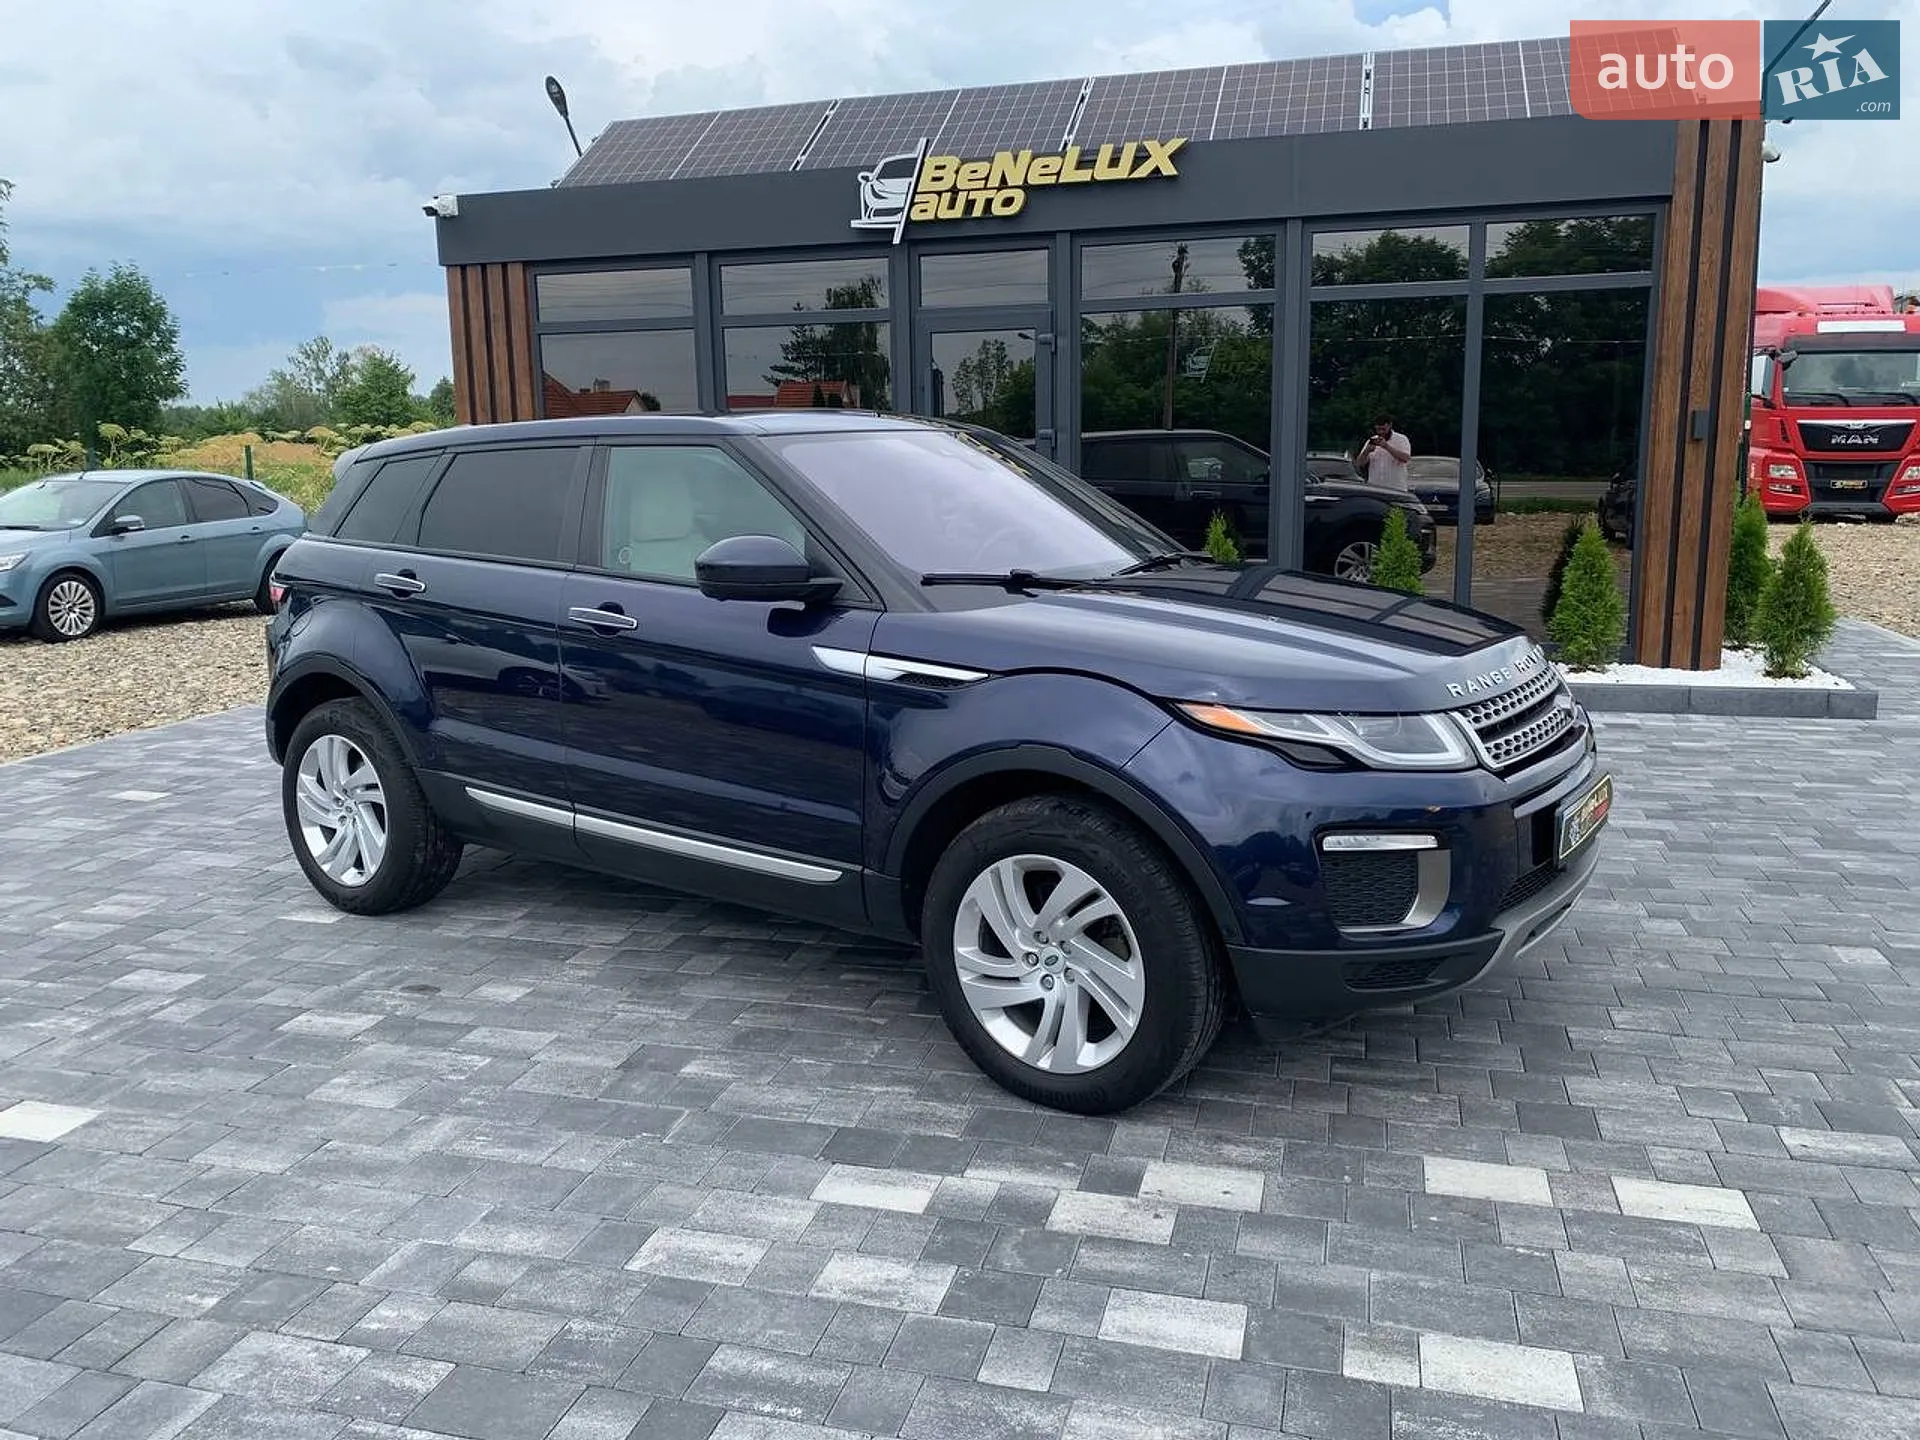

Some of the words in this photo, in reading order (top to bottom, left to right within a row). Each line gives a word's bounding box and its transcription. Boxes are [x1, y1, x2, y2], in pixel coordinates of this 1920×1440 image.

[917, 138, 1188, 193] BeNeLUX
[1831, 434, 1880, 444] MAN
[1446, 667, 1512, 698] RANGE
